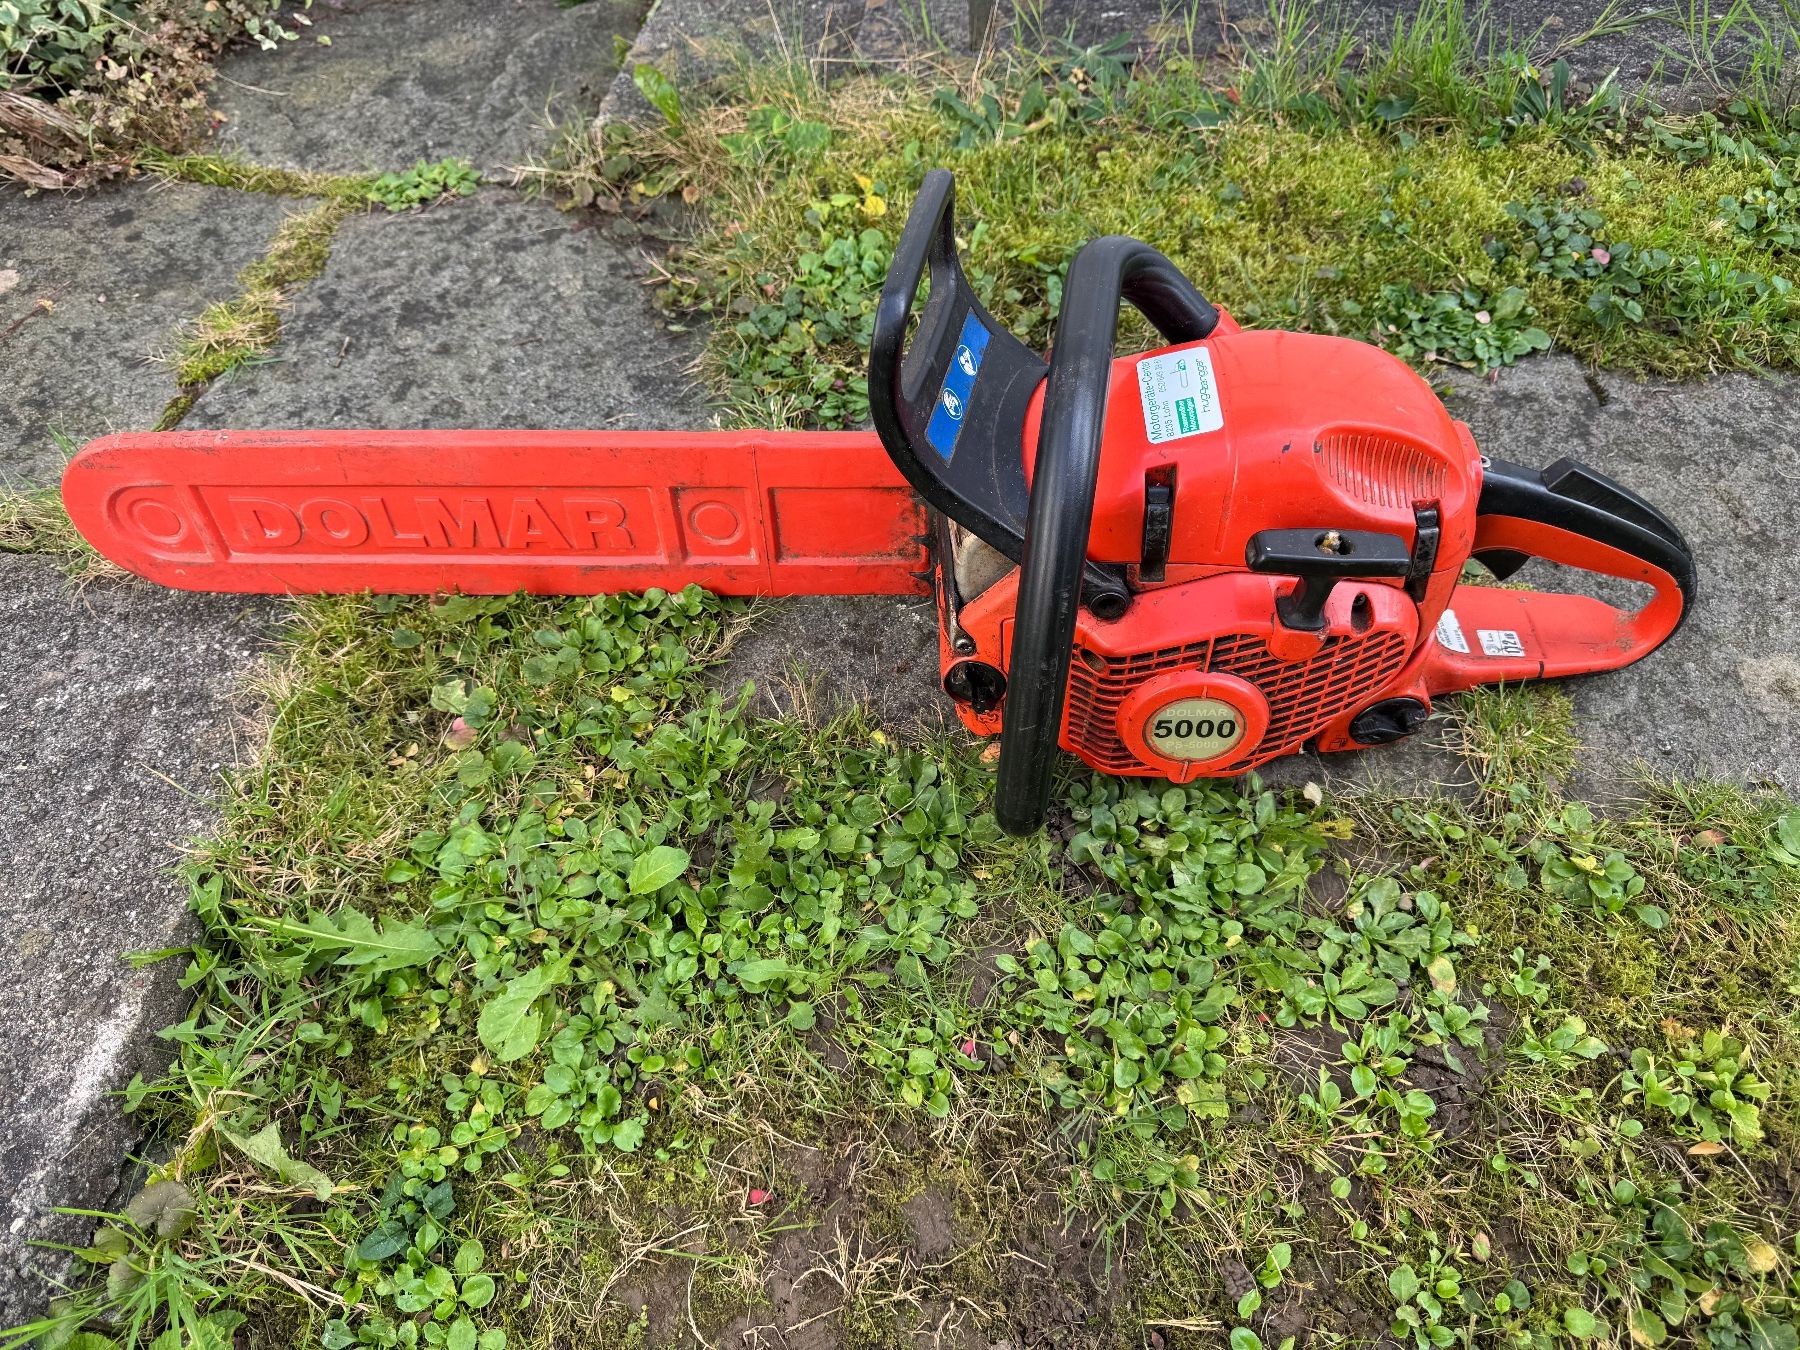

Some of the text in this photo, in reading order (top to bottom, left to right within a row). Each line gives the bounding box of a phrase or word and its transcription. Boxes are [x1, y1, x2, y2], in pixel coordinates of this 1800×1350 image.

[1142, 361, 1162, 440] Motorgeräte-Center
[1162, 401, 1171, 417] Lohn
[1165, 420, 1174, 437] 8235
[228, 496, 638, 549] DOLMAR
[1166, 708, 1228, 717] DOLMAR
[1153, 720, 1236, 738] 5000
